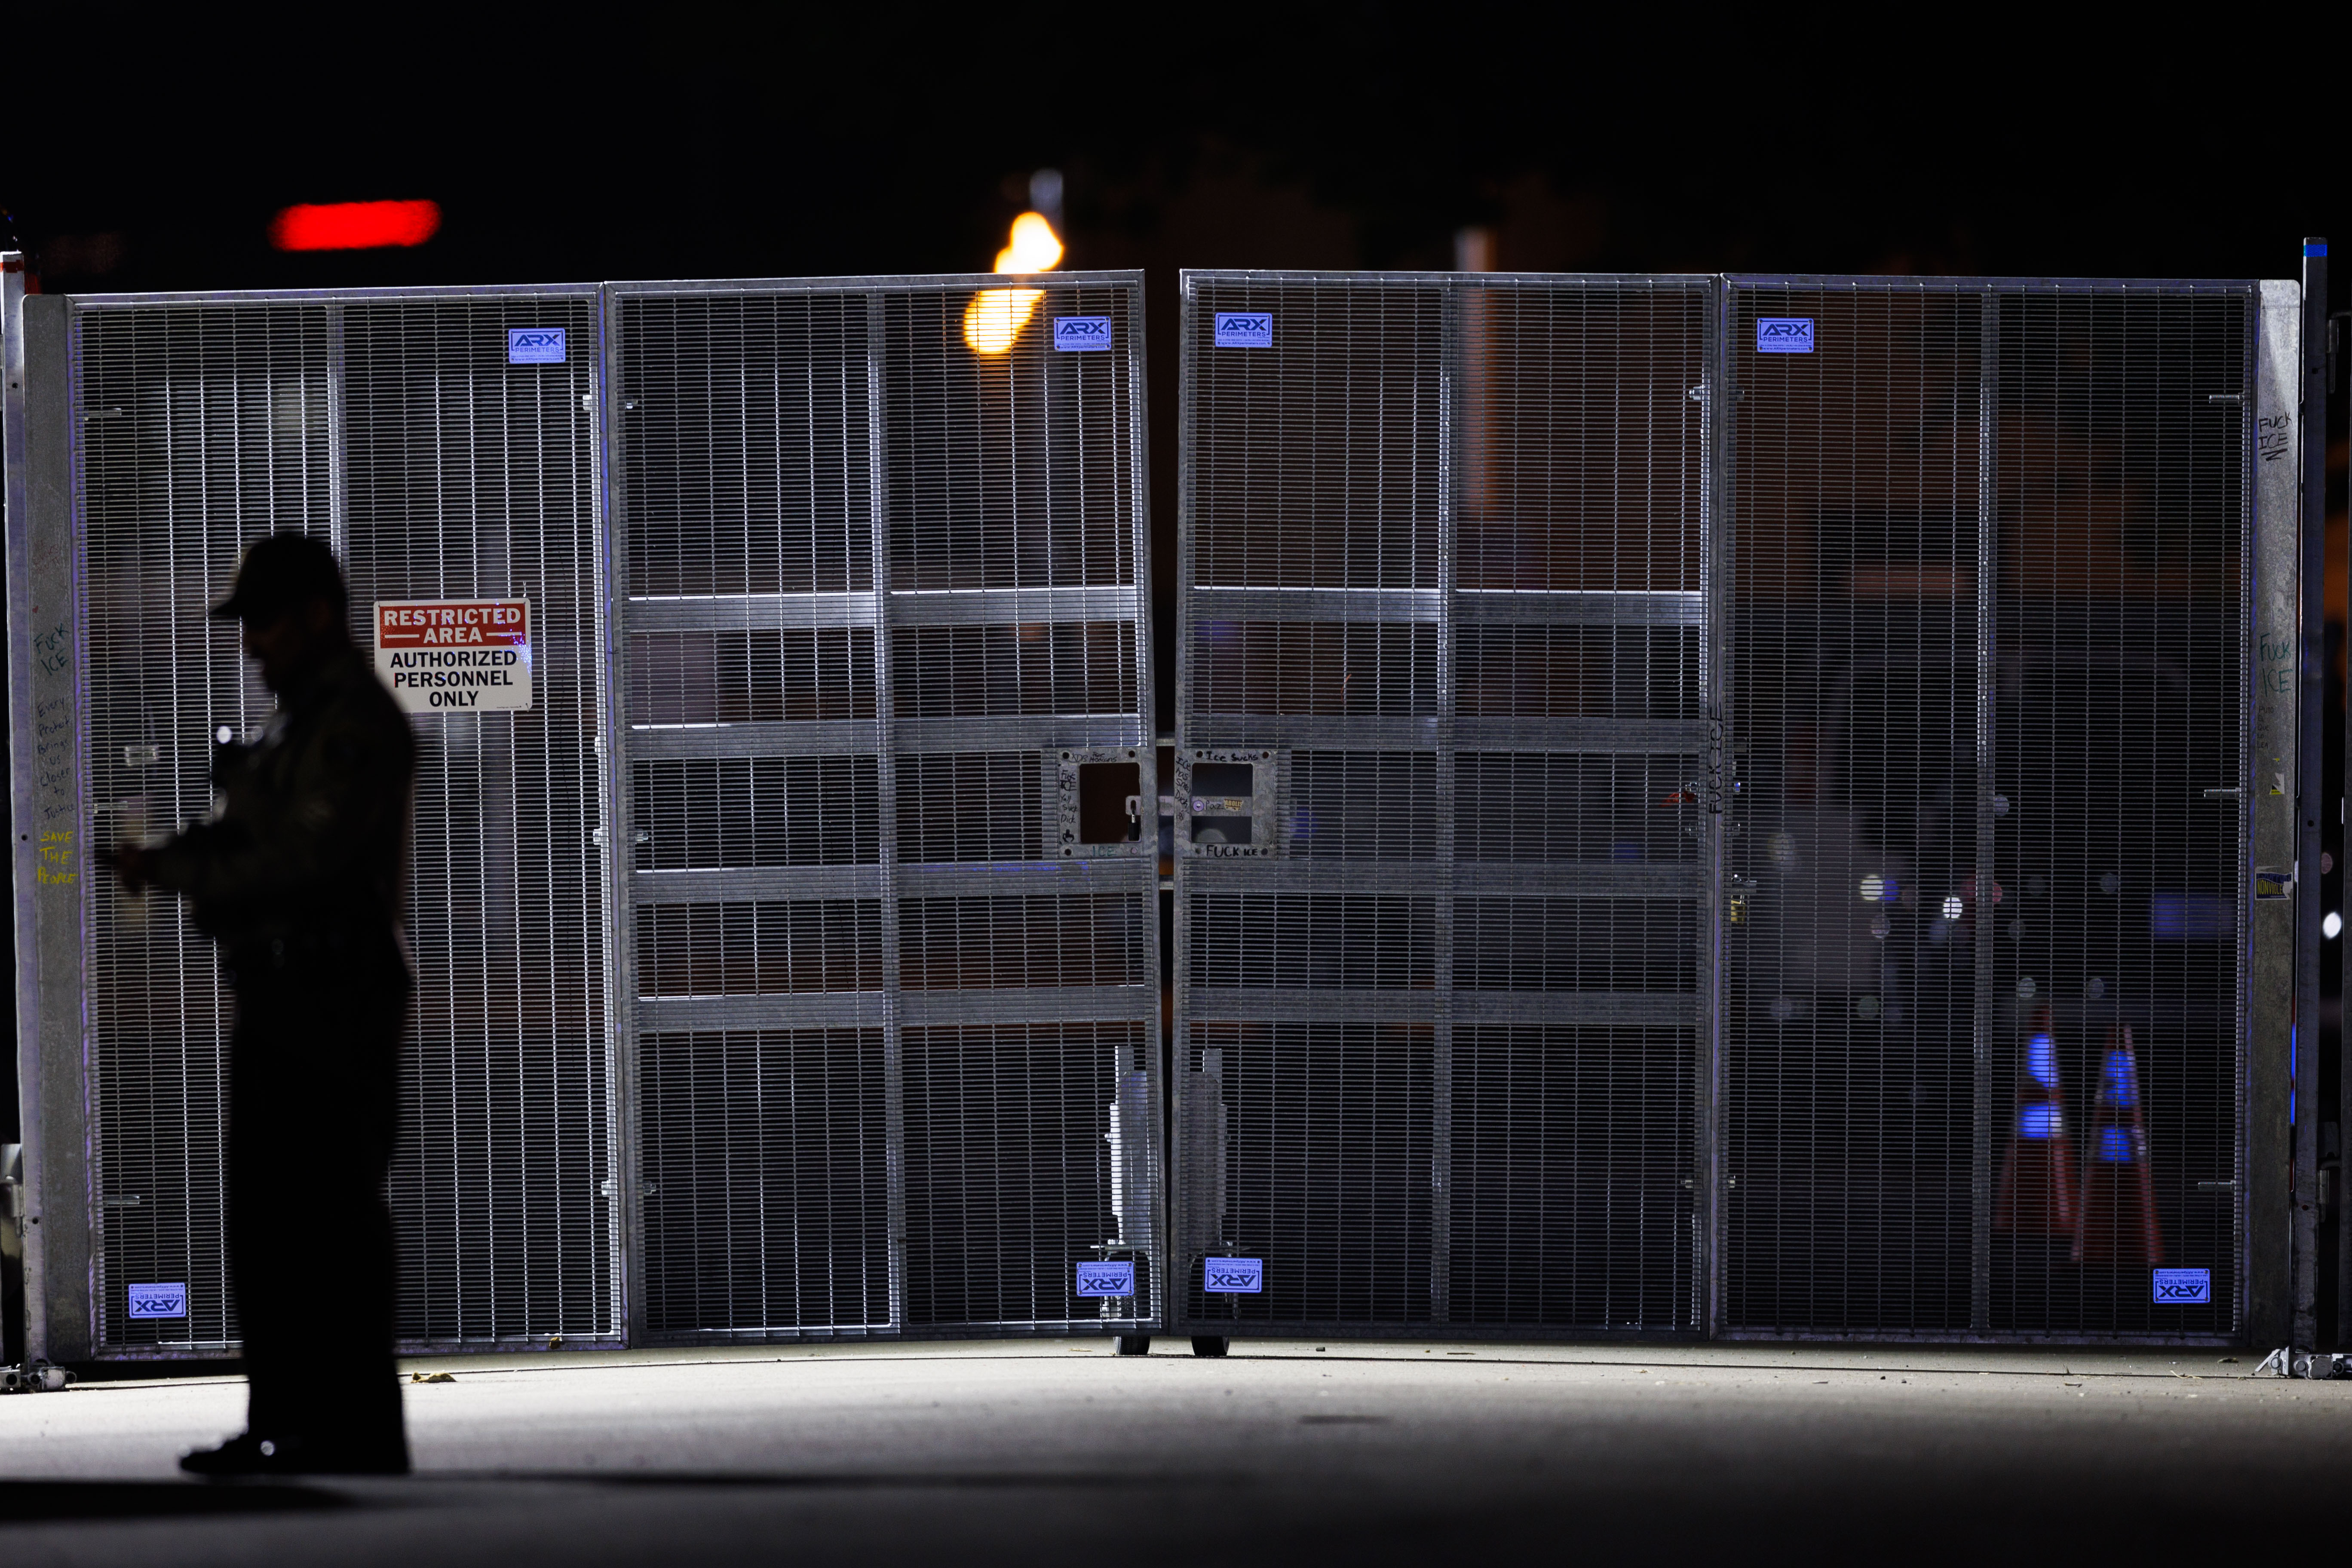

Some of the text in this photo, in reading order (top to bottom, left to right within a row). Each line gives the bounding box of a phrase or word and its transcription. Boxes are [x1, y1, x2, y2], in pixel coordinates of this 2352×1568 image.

[1060, 322, 1106, 334] ARX
[1221, 318, 1267, 331] ARX
[1763, 324, 1809, 336] ARX
[515, 334, 560, 346] ARX
[2259, 411, 2293, 432] FUCK
[2259, 433, 2288, 450] ICE
[384, 608, 520, 626] RESTRICTED
[34, 623, 70, 654] FUCK
[423, 627, 483, 644] AREA
[41, 647, 69, 676] ICE
[390, 650, 517, 668] AUTHORIZED
[394, 670, 513, 688] PERSONNEL
[2263, 668, 2293, 697] ICE
[429, 690, 479, 707] ONLY
[37, 698, 64, 717] Every
[1206, 751, 1227, 761] Ice
[1708, 702, 1723, 813] FUCK ICE
[1205, 799, 1224, 810] Paz
[40, 830, 73, 843] SAVE
[39, 846, 73, 864] THE
[1093, 846, 1117, 856] ICE
[1207, 844, 1239, 857] FUCK
[1082, 1278, 1128, 1290] ARX
[1211, 1274, 1256, 1286] ARX
[2159, 1285, 2205, 1297] ARX
[135, 1299, 180, 1312] ARX
